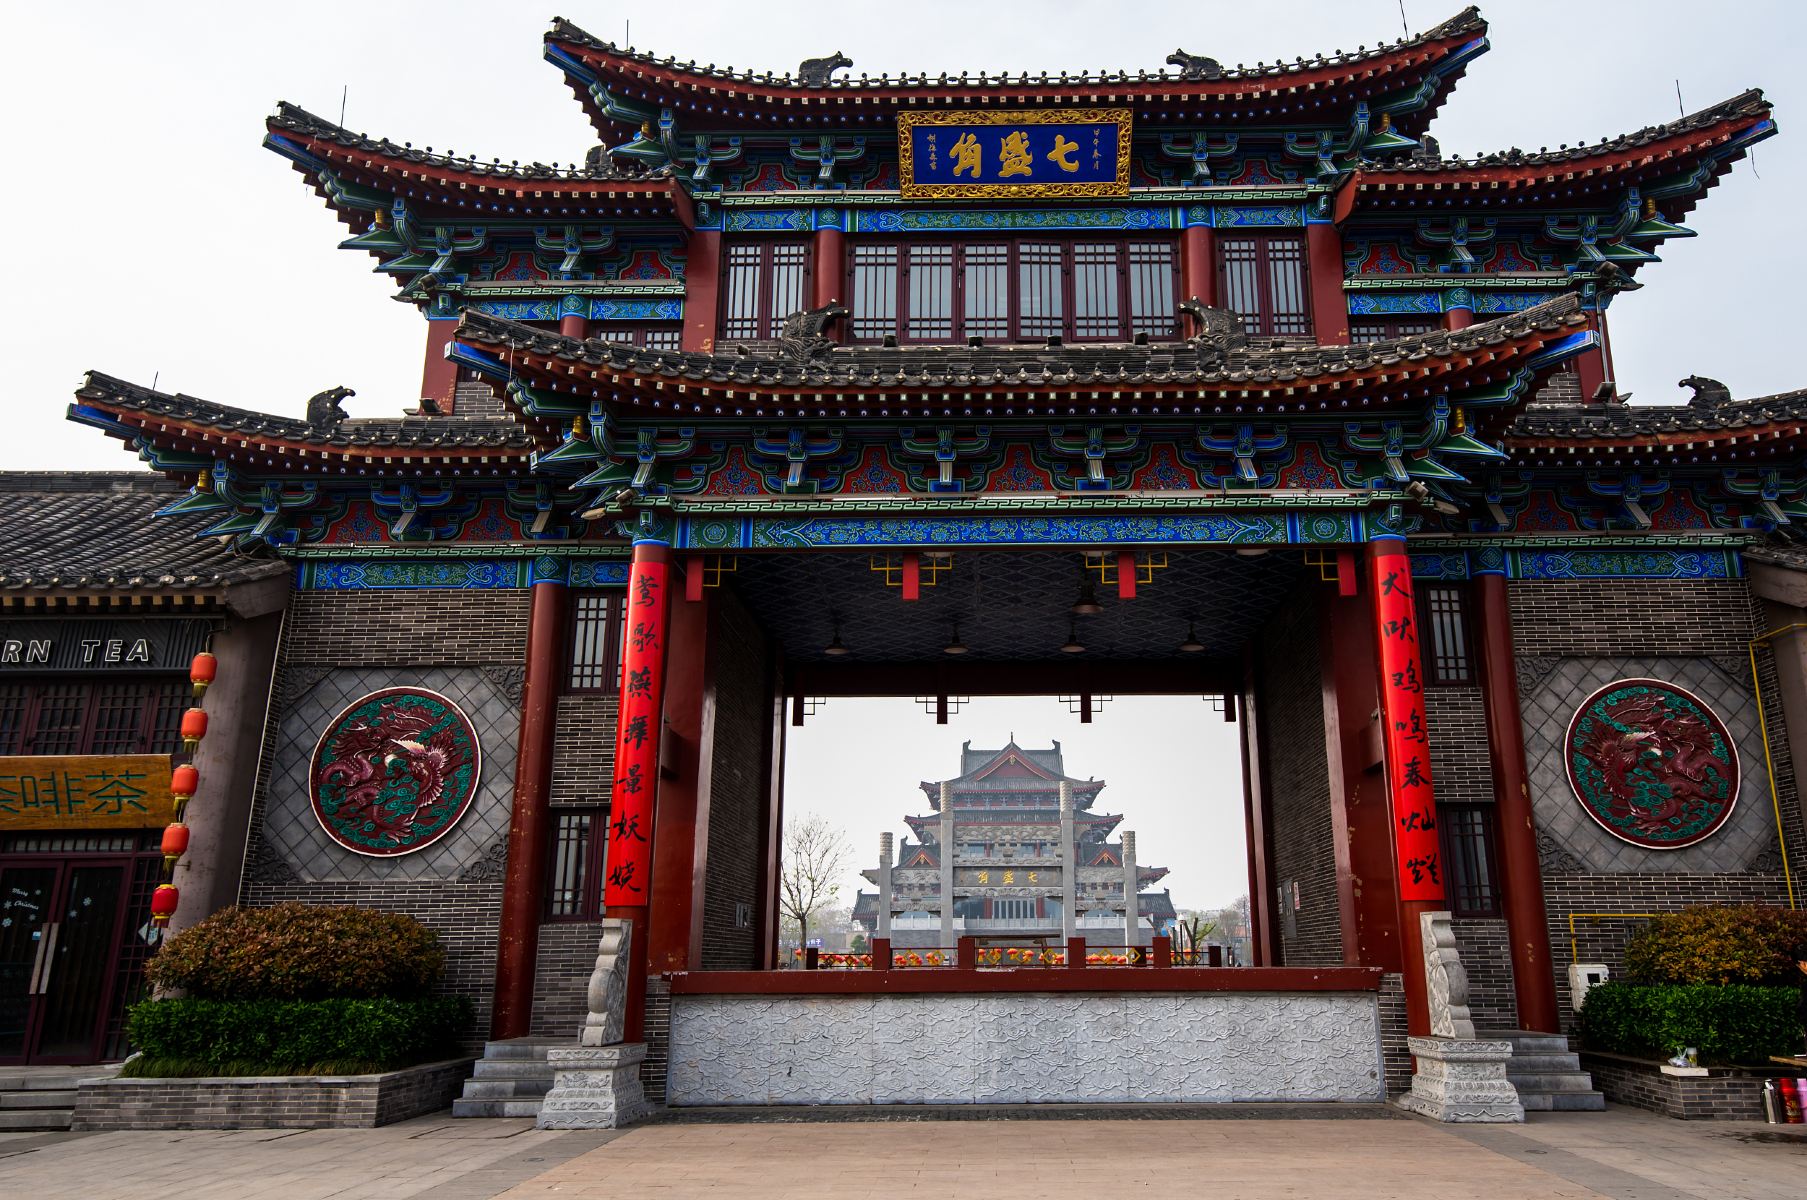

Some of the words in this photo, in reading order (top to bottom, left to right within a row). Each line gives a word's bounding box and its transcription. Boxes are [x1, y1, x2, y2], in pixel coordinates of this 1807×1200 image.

[949, 130, 1079, 178] 七盛角
[1, 639, 51, 662] RN
[81, 638, 149, 662] TEA
[978, 870, 1038, 884] 七盛角
